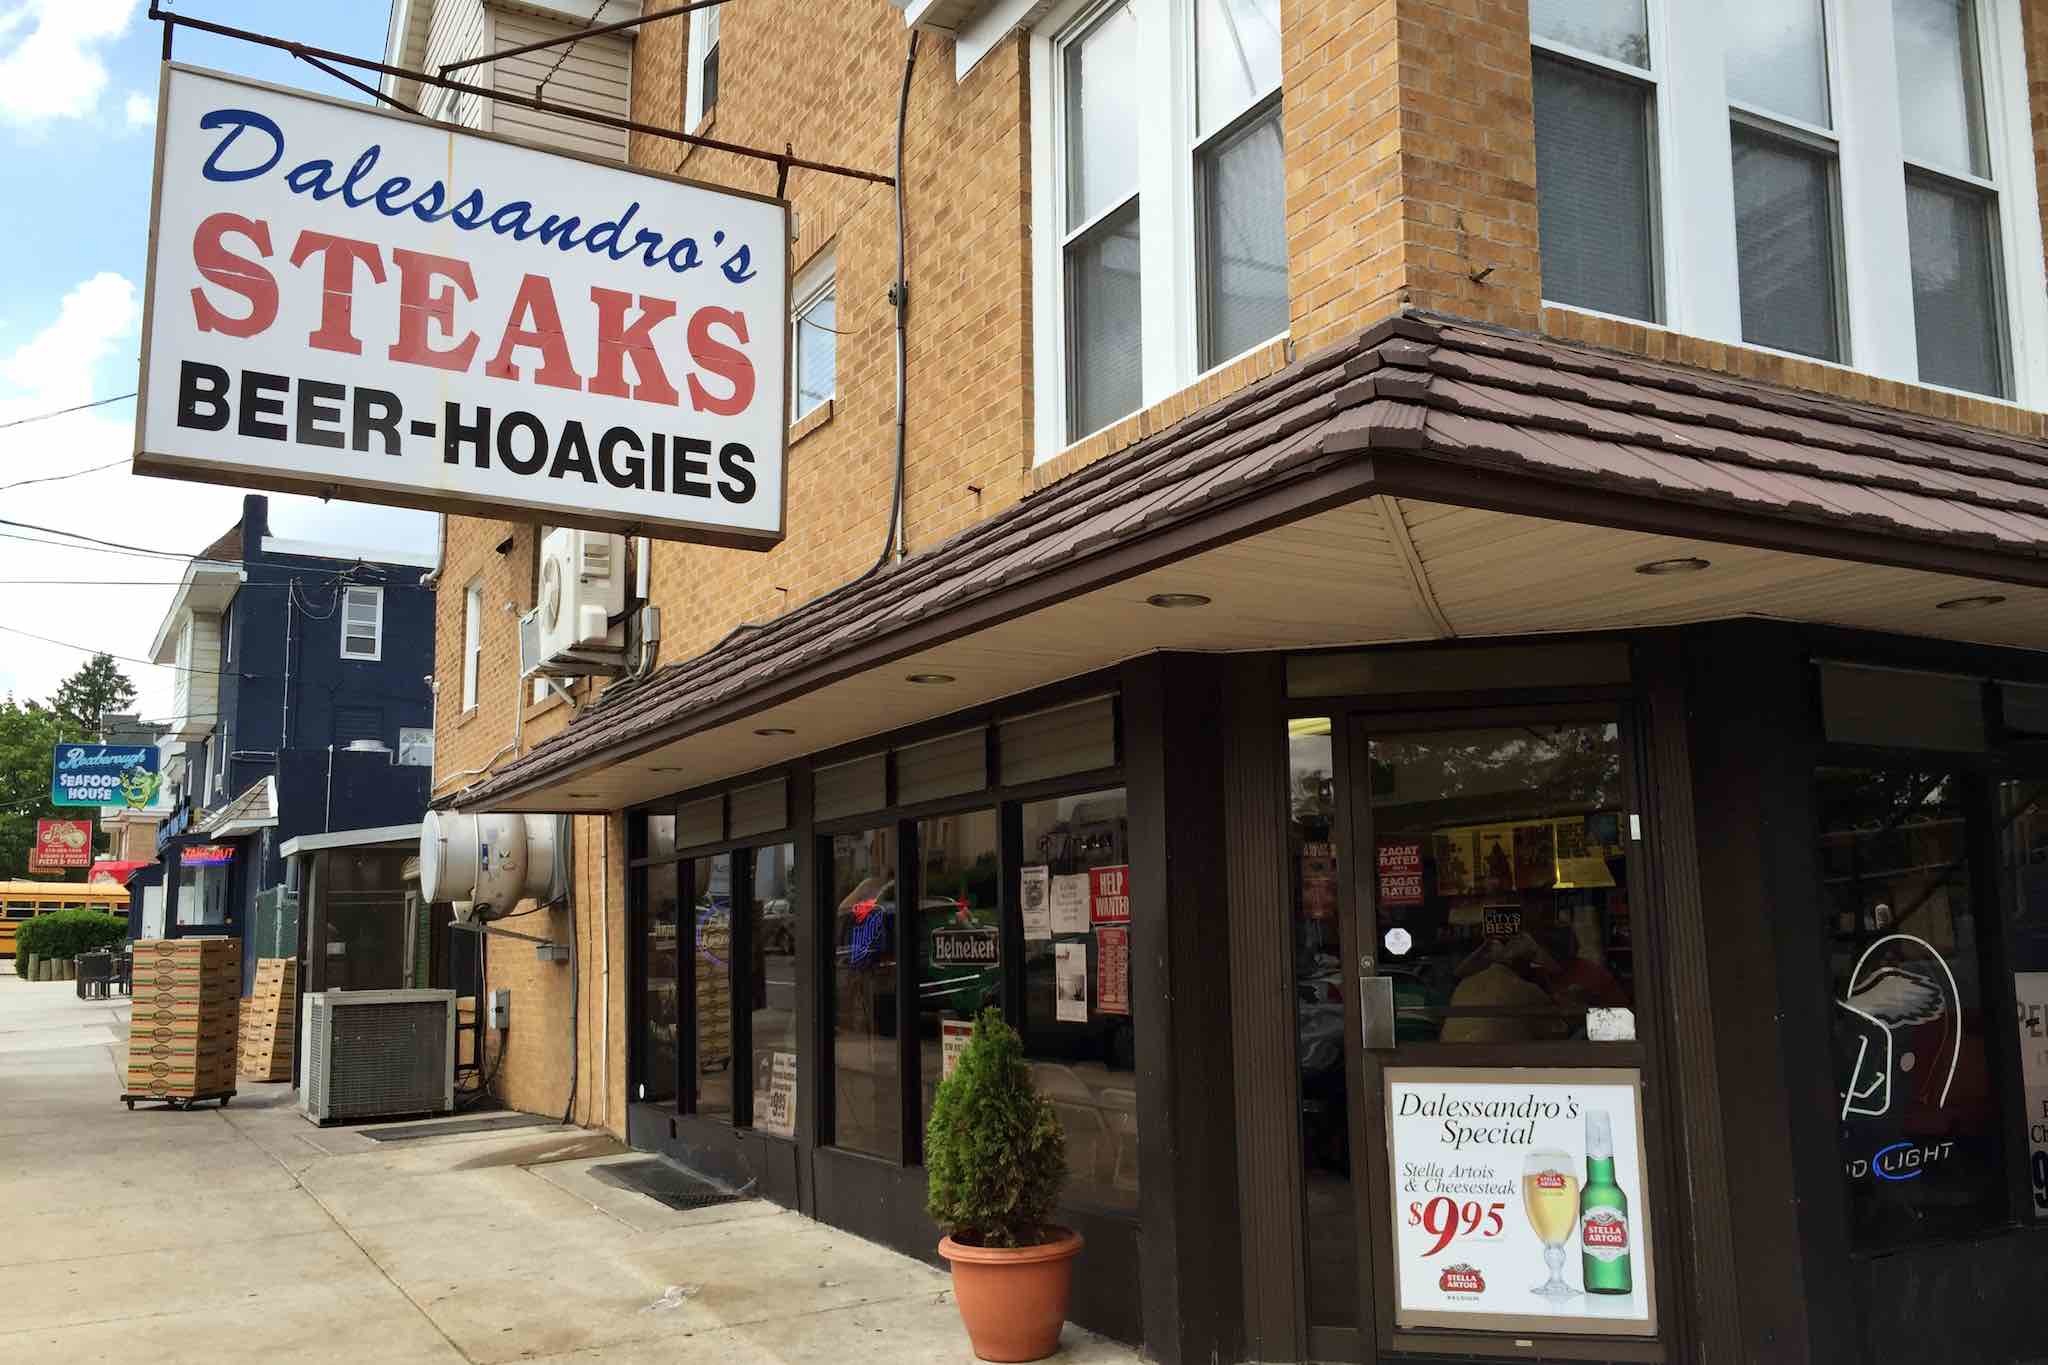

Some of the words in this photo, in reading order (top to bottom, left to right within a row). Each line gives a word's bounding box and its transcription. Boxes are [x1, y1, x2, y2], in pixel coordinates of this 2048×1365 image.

[199, 108, 758, 284] Dalessandro's
[190, 211, 757, 416] STEAKS
[176, 359, 757, 504] BEER-HOAGIES
[60, 773, 121, 788] SEAFOOD
[68, 787, 112, 800] HOUSE
[1380, 855, 1419, 865] RATED
[1100, 871, 1124, 896] HELP
[1096, 895, 1129, 917] WANTED
[935, 935, 995, 960] Heineken
[1399, 1092, 1580, 1120] Dalessandro's
[1440, 1119, 1536, 1150] Special
[1884, 1142, 1955, 1171] LIGHT
[1402, 1162, 1444, 1180] Stella
[1448, 1163, 1495, 1179] Artois
[1403, 1180, 1418, 1193] &
[1423, 1179, 1518, 1196] Cheesesteak
[1588, 1225, 1622, 1235] STELLA
[1588, 1233, 1623, 1243] ARTOIS
